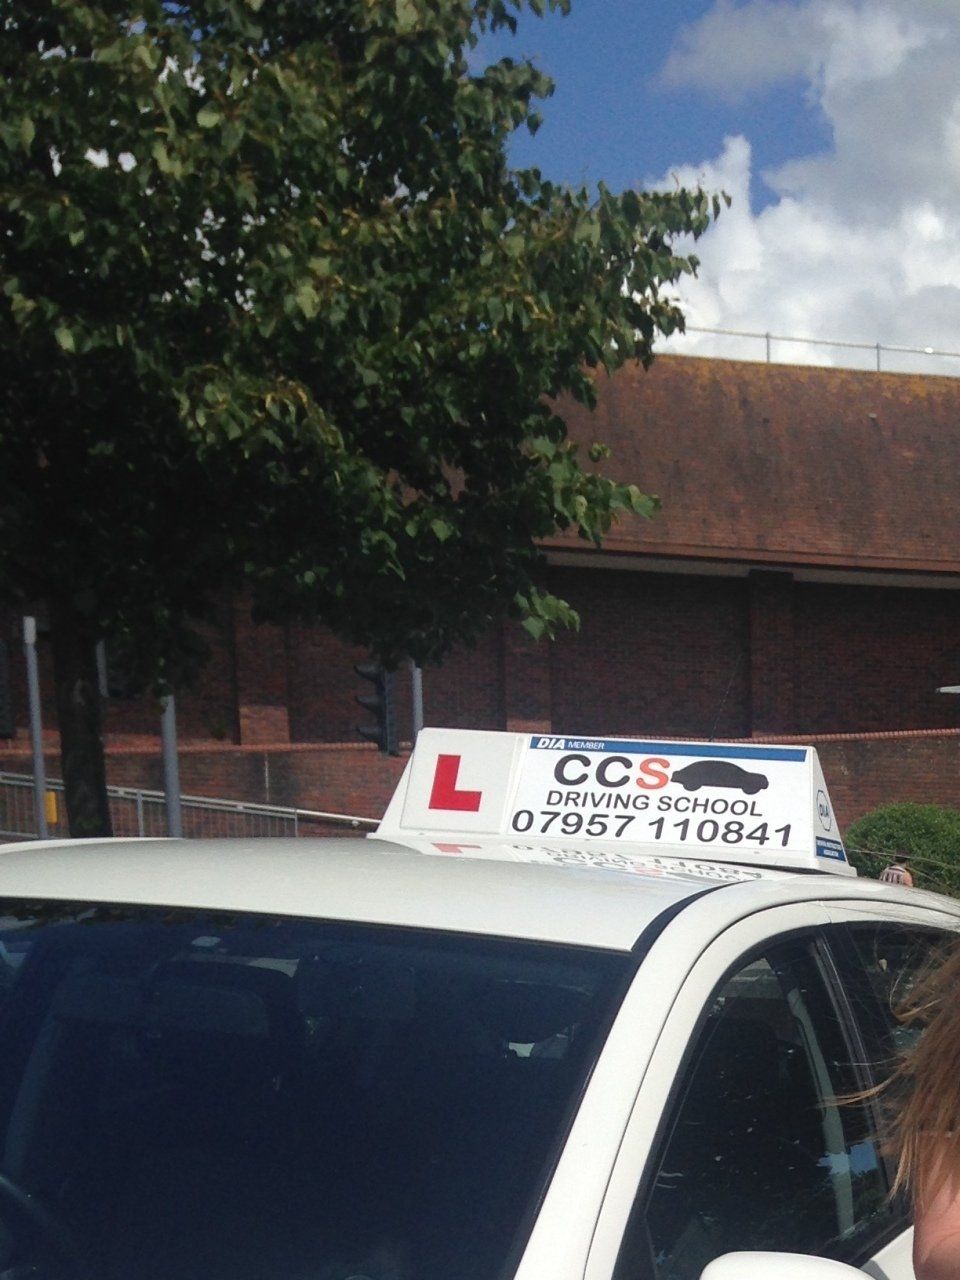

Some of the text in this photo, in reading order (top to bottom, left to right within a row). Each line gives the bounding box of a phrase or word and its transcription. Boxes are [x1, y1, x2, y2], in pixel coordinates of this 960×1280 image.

[537, 737, 605, 750] DIA MEMBER
[428, 754, 482, 812] L
[554, 754, 671, 790] CCS
[546, 790, 763, 817] DRIVING SCHOOL
[511, 808, 792, 847] 07957 110841
